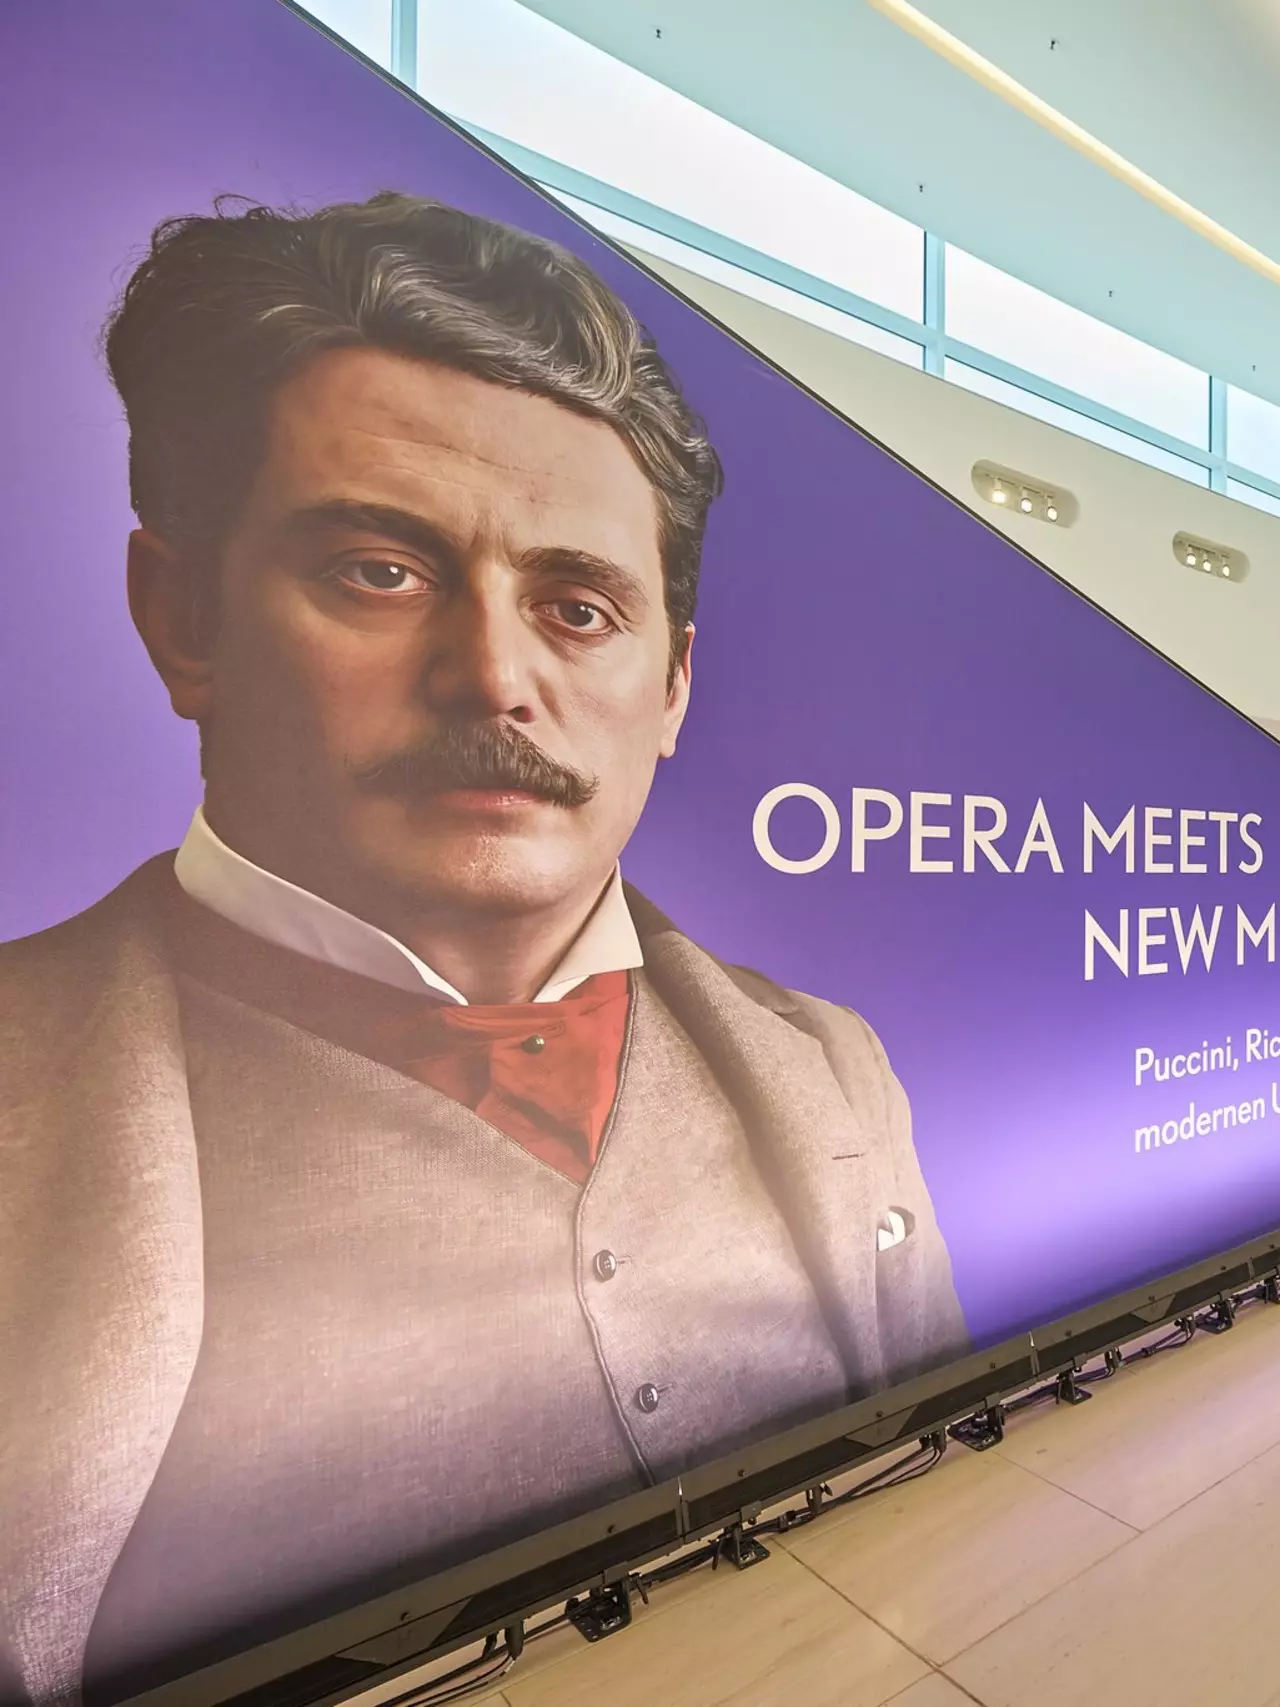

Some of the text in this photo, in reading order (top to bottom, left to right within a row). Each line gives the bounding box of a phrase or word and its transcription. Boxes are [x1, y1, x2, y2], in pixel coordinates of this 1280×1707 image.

[752, 782, 1264, 875] OPERA MEETS
[1084, 902, 1224, 981] NEW
[1134, 1036, 1240, 1086] Puccini,
[1134, 1097, 1266, 1154] modernen
